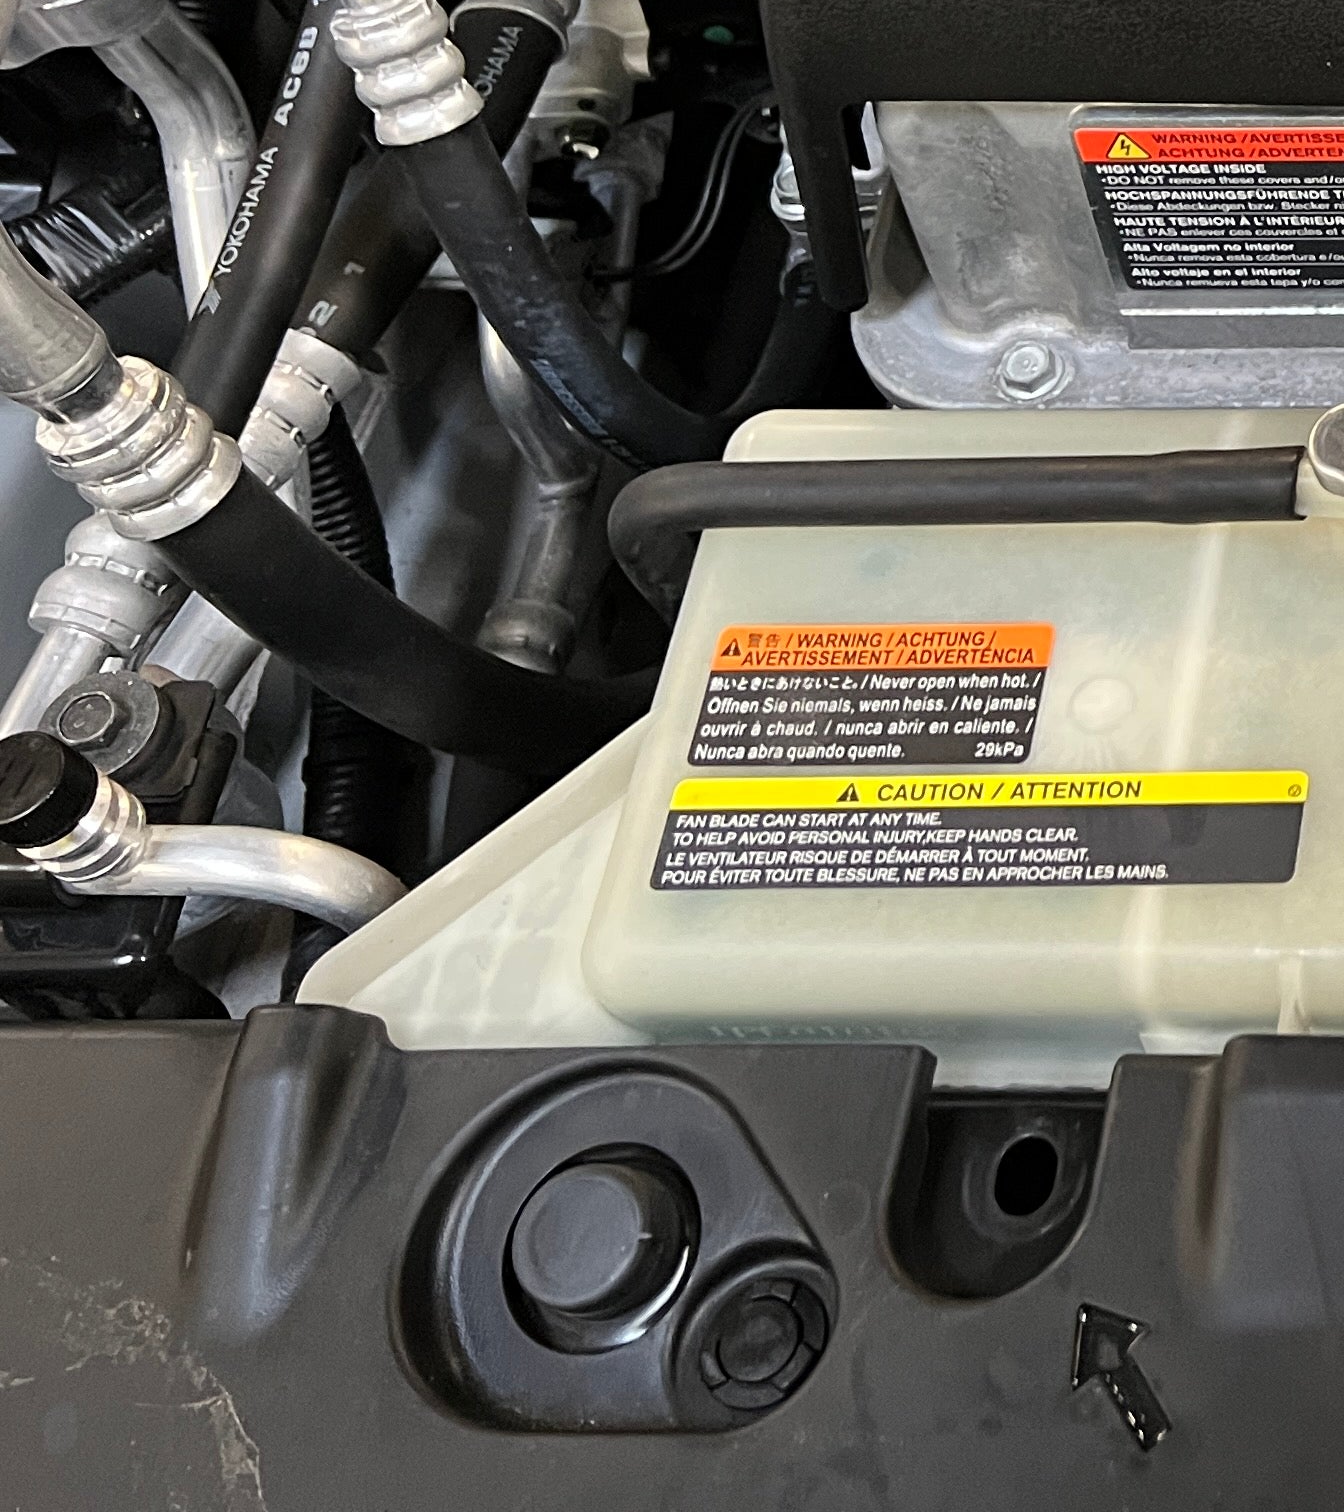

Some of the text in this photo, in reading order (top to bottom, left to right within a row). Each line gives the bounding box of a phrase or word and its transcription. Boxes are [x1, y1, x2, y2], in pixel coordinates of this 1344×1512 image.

[473, 27, 524, 97] OHAMA
[1152, 133, 1236, 145] WARNING
[1158, 147, 1244, 158] ACHTUNG
[1095, 164, 1266, 174] HIGH VOLTAGE INSIDE
[1104, 188, 1331, 200] HOCHSPANNUNGSFÜHRENDE
[214, 146, 279, 278] YOKOHAMA
[1113, 217, 1166, 226] HAUTE
[1169, 217, 1236, 226] TENSION
[1123, 242, 1150, 252] Alta
[1152, 242, 1220, 253] Voltagem
[1131, 267, 1160, 276] Alto
[1162, 267, 1210, 278] voltaje
[1234, 267, 1248, 276] el
[797, 632, 883, 648] WARNING
[895, 631, 985, 647] ACHTUNG
[741, 650, 894, 666] AVERTISSEMENT
[869, 674, 917, 689] Never
[917, 675, 956, 692] open
[958, 673, 999, 689] when
[1000, 673, 1030, 689] hot.
[762, 697, 788, 714] Sie
[790, 697, 855, 715] niemals,
[859, 698, 900, 713] wenn
[902, 696, 948, 712] heiss.
[961, 695, 982, 711] Ne
[982, 694, 1037, 715] jamais
[700, 720, 748, 736] ouvrir
[750, 720, 762, 736] à
[766, 720, 818, 736] chaud.
[835, 722, 883, 735] nunca
[887, 718, 925, 735] abrir
[928, 721, 949, 734] en
[953, 717, 1019, 734] caliente.
[694, 741, 1025, 763] Nunca abra quando quente. 29kPa
[877, 782, 985, 802] CAUTION
[1010, 780, 1141, 800] ATTENTION
[676, 811, 943, 828] FAN BLADE CAN START AT ANY TIME.
[672, 832, 693, 846] TO
[695, 831, 738, 846] HELP
[737, 831, 786, 846] AVOID
[787, 829, 870, 845] PERSONAL
[968, 828, 1023, 843] HANDS
[1025, 828, 1079, 843] CLEAR.
[665, 845, 1090, 867] LE VENTILATEUR RISQUE DE DÉMARRER À TOUT MOMENT.
[661, 864, 1168, 885] POUR ÉVITER TOUTE BLESSURE, NE PAS EN APPROCHER LES MAINS.
